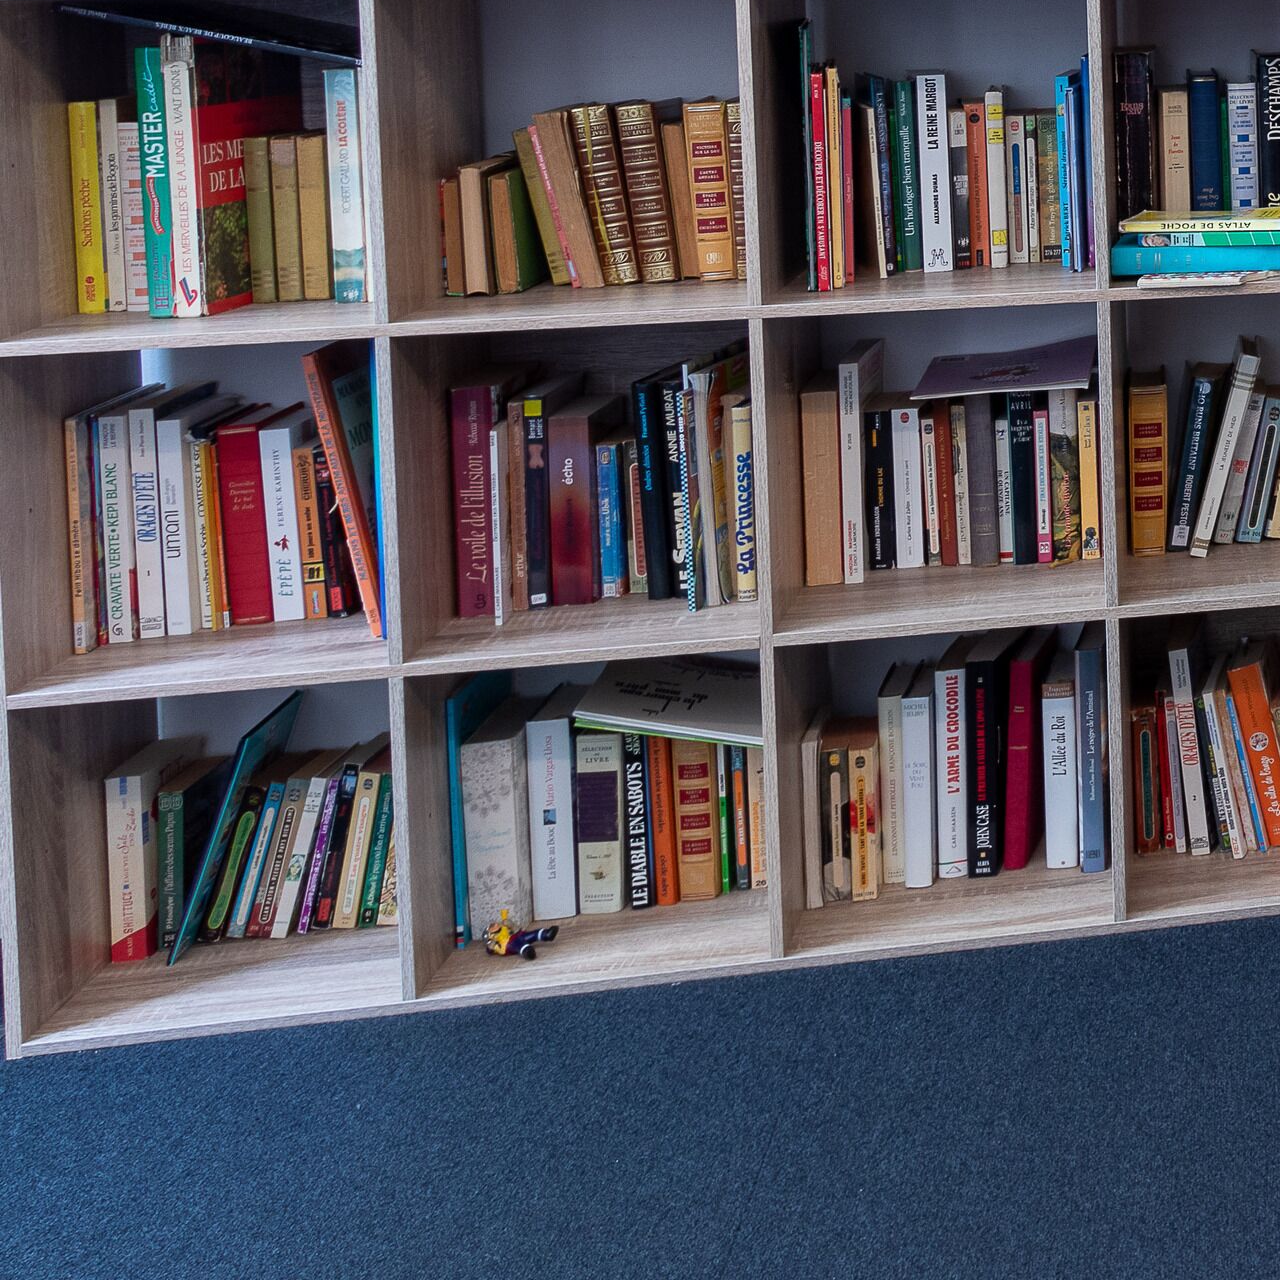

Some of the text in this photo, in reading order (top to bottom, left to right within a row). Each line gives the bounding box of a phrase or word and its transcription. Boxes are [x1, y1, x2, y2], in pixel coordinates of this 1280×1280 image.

[143, 112, 165, 178] MASTER
[925, 78, 939, 150] LA REINE MARGOT
[107, 153, 118, 182] Bogota
[203, 143, 224, 164] LES
[209, 172, 225, 192] DE
[814, 141, 823, 172] DÉCOUPER
[899, 125, 915, 236] Un horloger bien tranquille
[172, 97, 192, 273] LES MERVEILLES DE LA JUNGLE WALT
[81, 209, 93, 247] Sachons
[663, 389, 679, 463] ANNIE MURAT
[1011, 402, 1031, 410] AVRIL
[561, 458, 574, 485] écho
[1183, 406, 1204, 501] RUNS BRITAIN? ROBERT
[131, 472, 156, 542] ORAGES D'ÉTÉ
[163, 510, 180, 559] umani
[460, 455, 487, 584] Le voile de l'illusion
[735, 451, 754, 575] La Princesse
[105, 463, 123, 620] CRAVATE VERTE KEPI BLANC
[353, 539, 368, 581] MAMANS
[515, 553, 524, 578] arthur
[945, 675, 959, 751] DU CROCODILE
[1177, 703, 1199, 766] ORAGES D'ÉTÉ
[1051, 715, 1067, 776] L'Allée du Roi
[545, 756, 554, 807] Mario Vargas
[626, 762, 648, 906] LE DIABLE EN SABOTS
[976, 805, 992, 849] JOHN CASE
